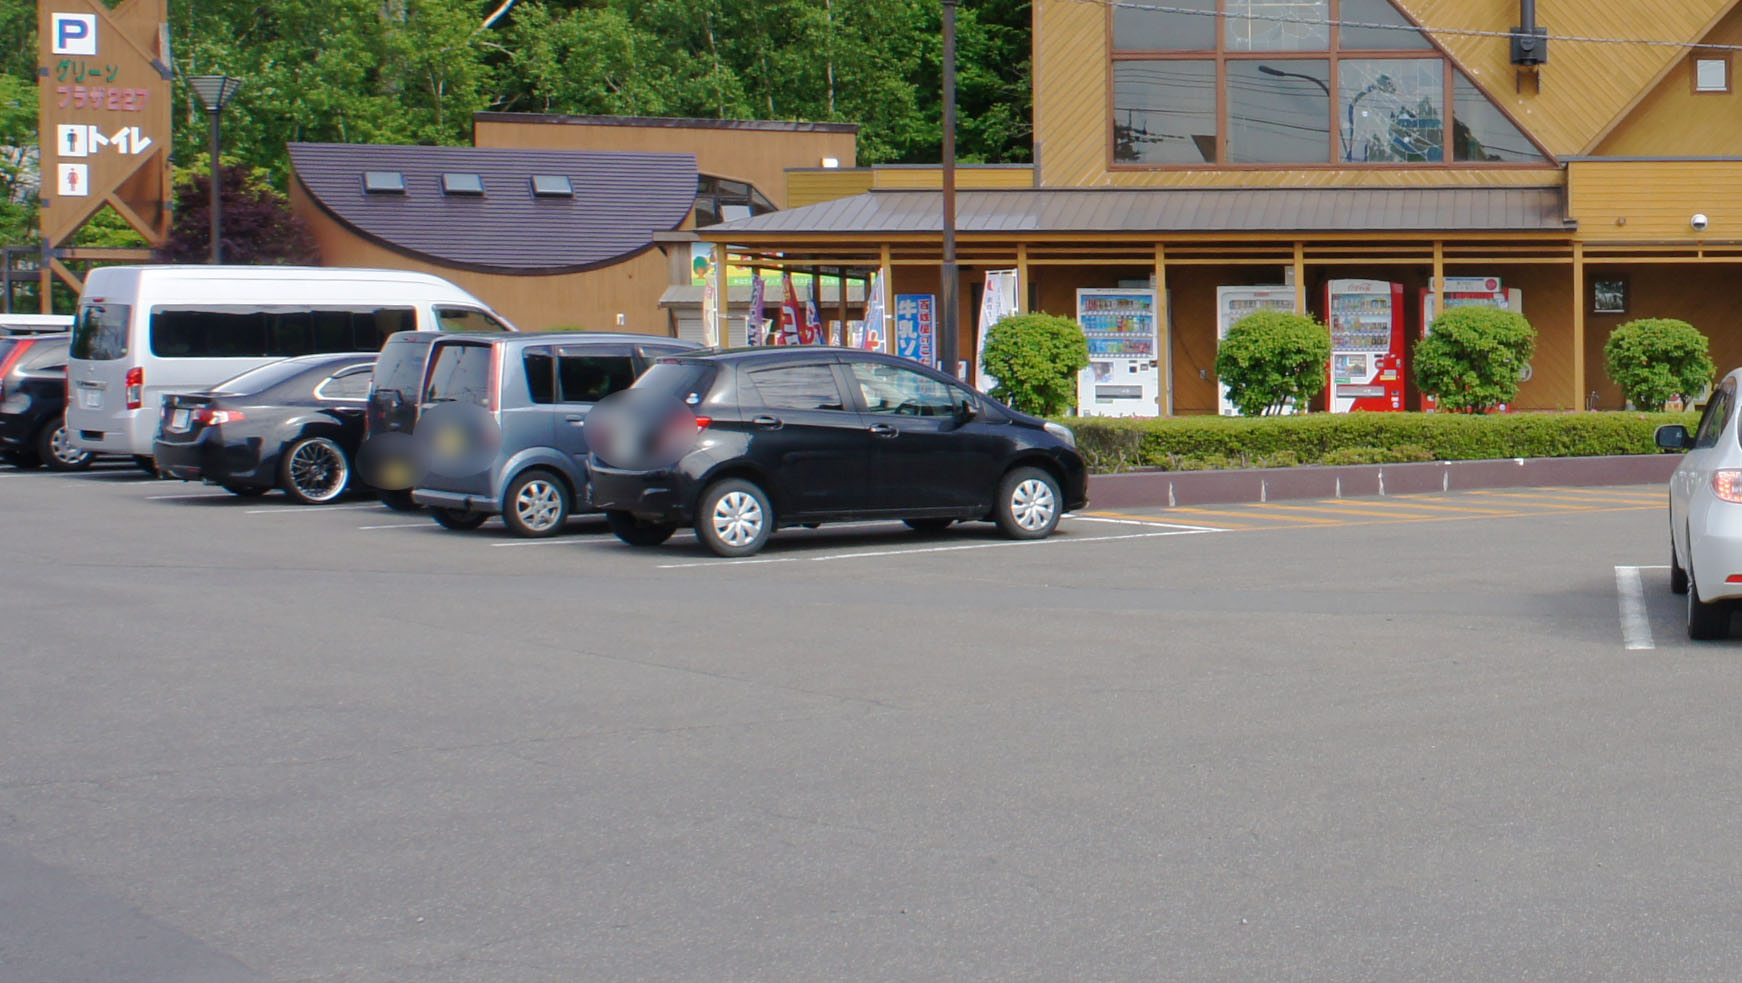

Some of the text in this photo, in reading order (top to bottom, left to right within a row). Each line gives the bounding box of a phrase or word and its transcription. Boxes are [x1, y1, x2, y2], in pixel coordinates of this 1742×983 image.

[58, 18, 89, 49] P
[56, 58, 120, 83] グリーン
[88, 124, 152, 154] トイレ
[898, 299, 918, 361] 牛乳ソ
